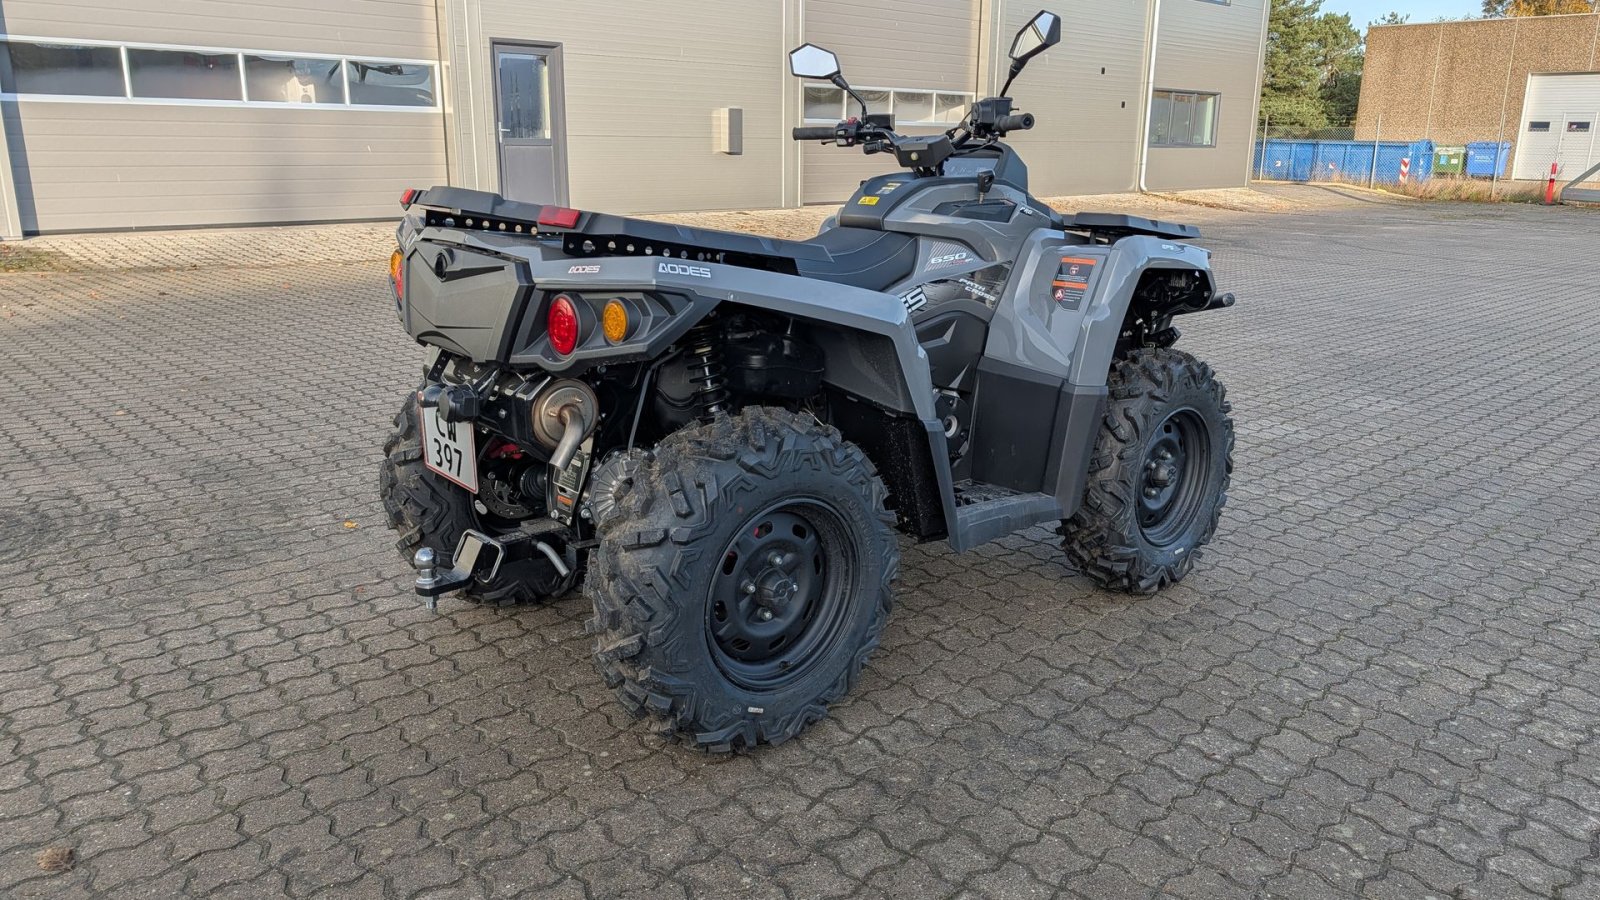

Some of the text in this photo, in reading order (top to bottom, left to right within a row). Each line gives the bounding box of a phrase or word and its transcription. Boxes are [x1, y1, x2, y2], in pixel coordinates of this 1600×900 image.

[931, 252, 967, 264] 650
[568, 265, 601, 274] AODES
[658, 262, 712, 278] AODES
[959, 278, 986, 291] PATH
[965, 286, 996, 301] CROSS
[433, 437, 462, 478] 397
